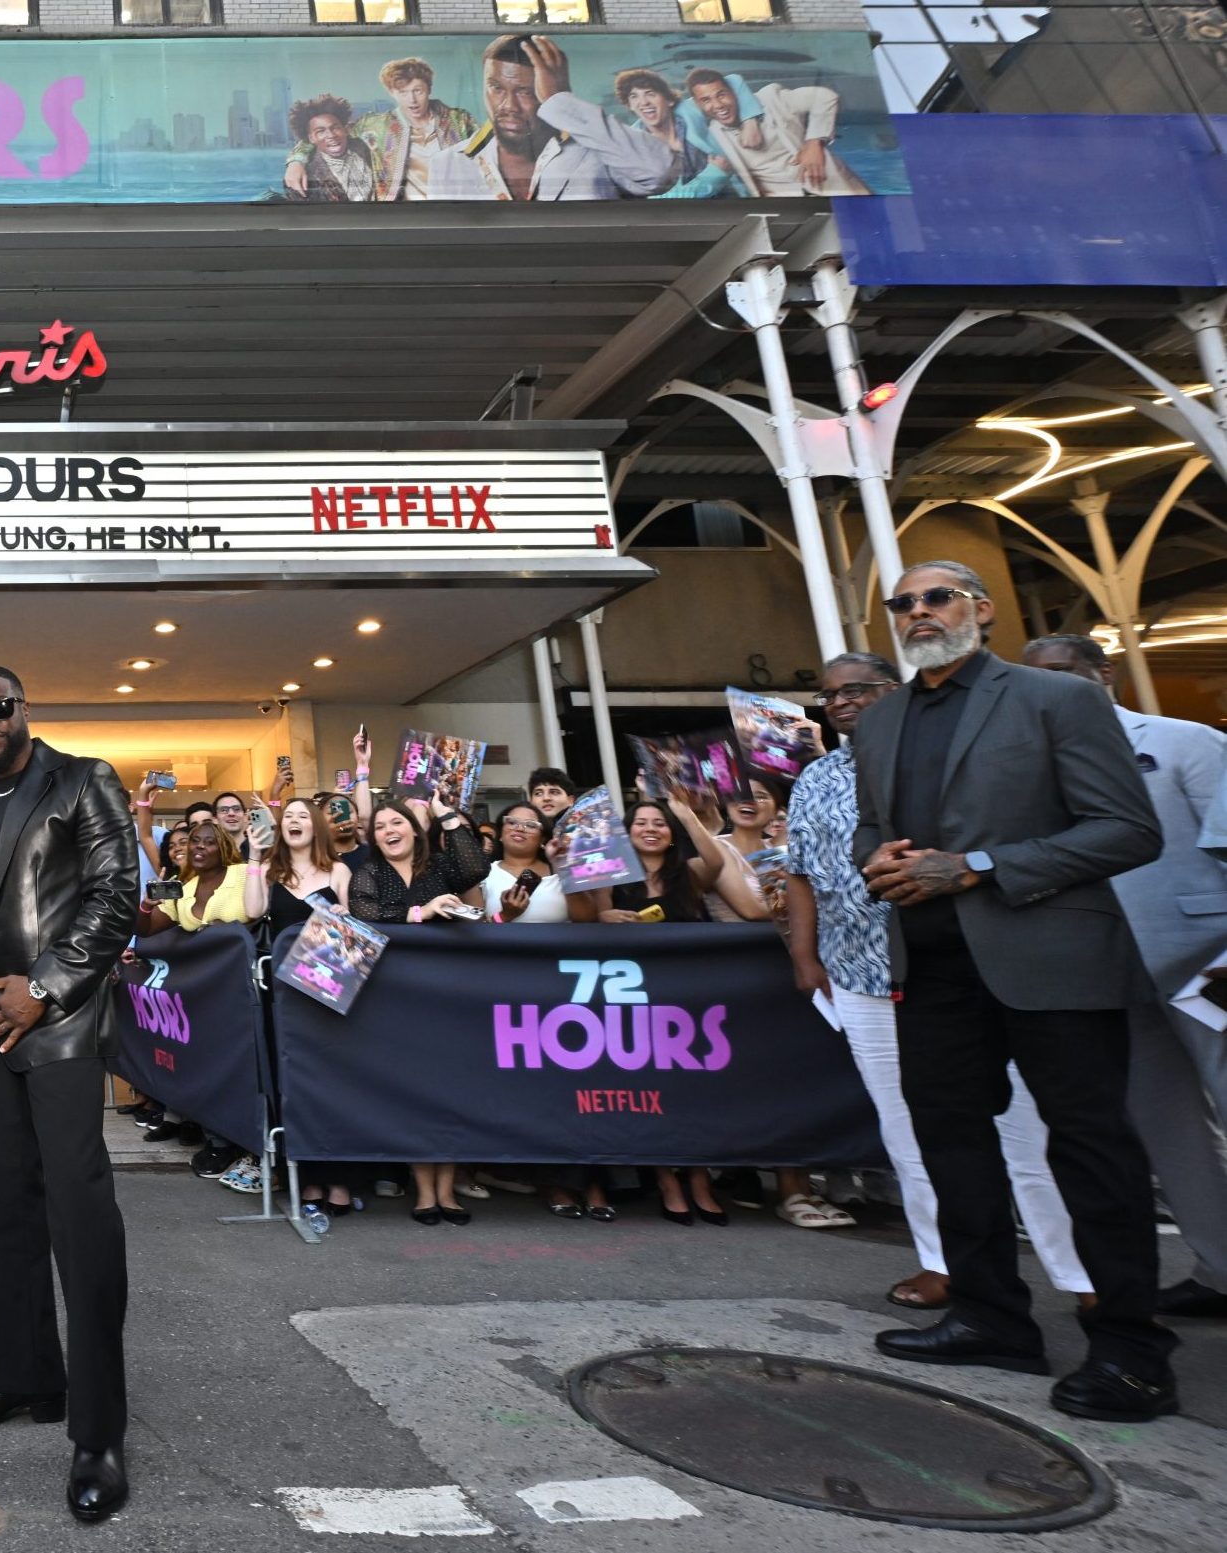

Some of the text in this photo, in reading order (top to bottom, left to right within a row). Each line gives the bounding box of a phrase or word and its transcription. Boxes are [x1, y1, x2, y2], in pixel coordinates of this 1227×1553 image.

[310, 485, 496, 533] NETFLIX
[86, 526, 125, 549] HE
[141, 525, 230, 550] ISN'T.
[594, 524, 611, 548] N
[559, 960, 649, 1004] 72
[127, 983, 190, 1045] HOURS
[493, 1003, 731, 1071] HOURS
[576, 1090, 663, 1115] NETFLIX
